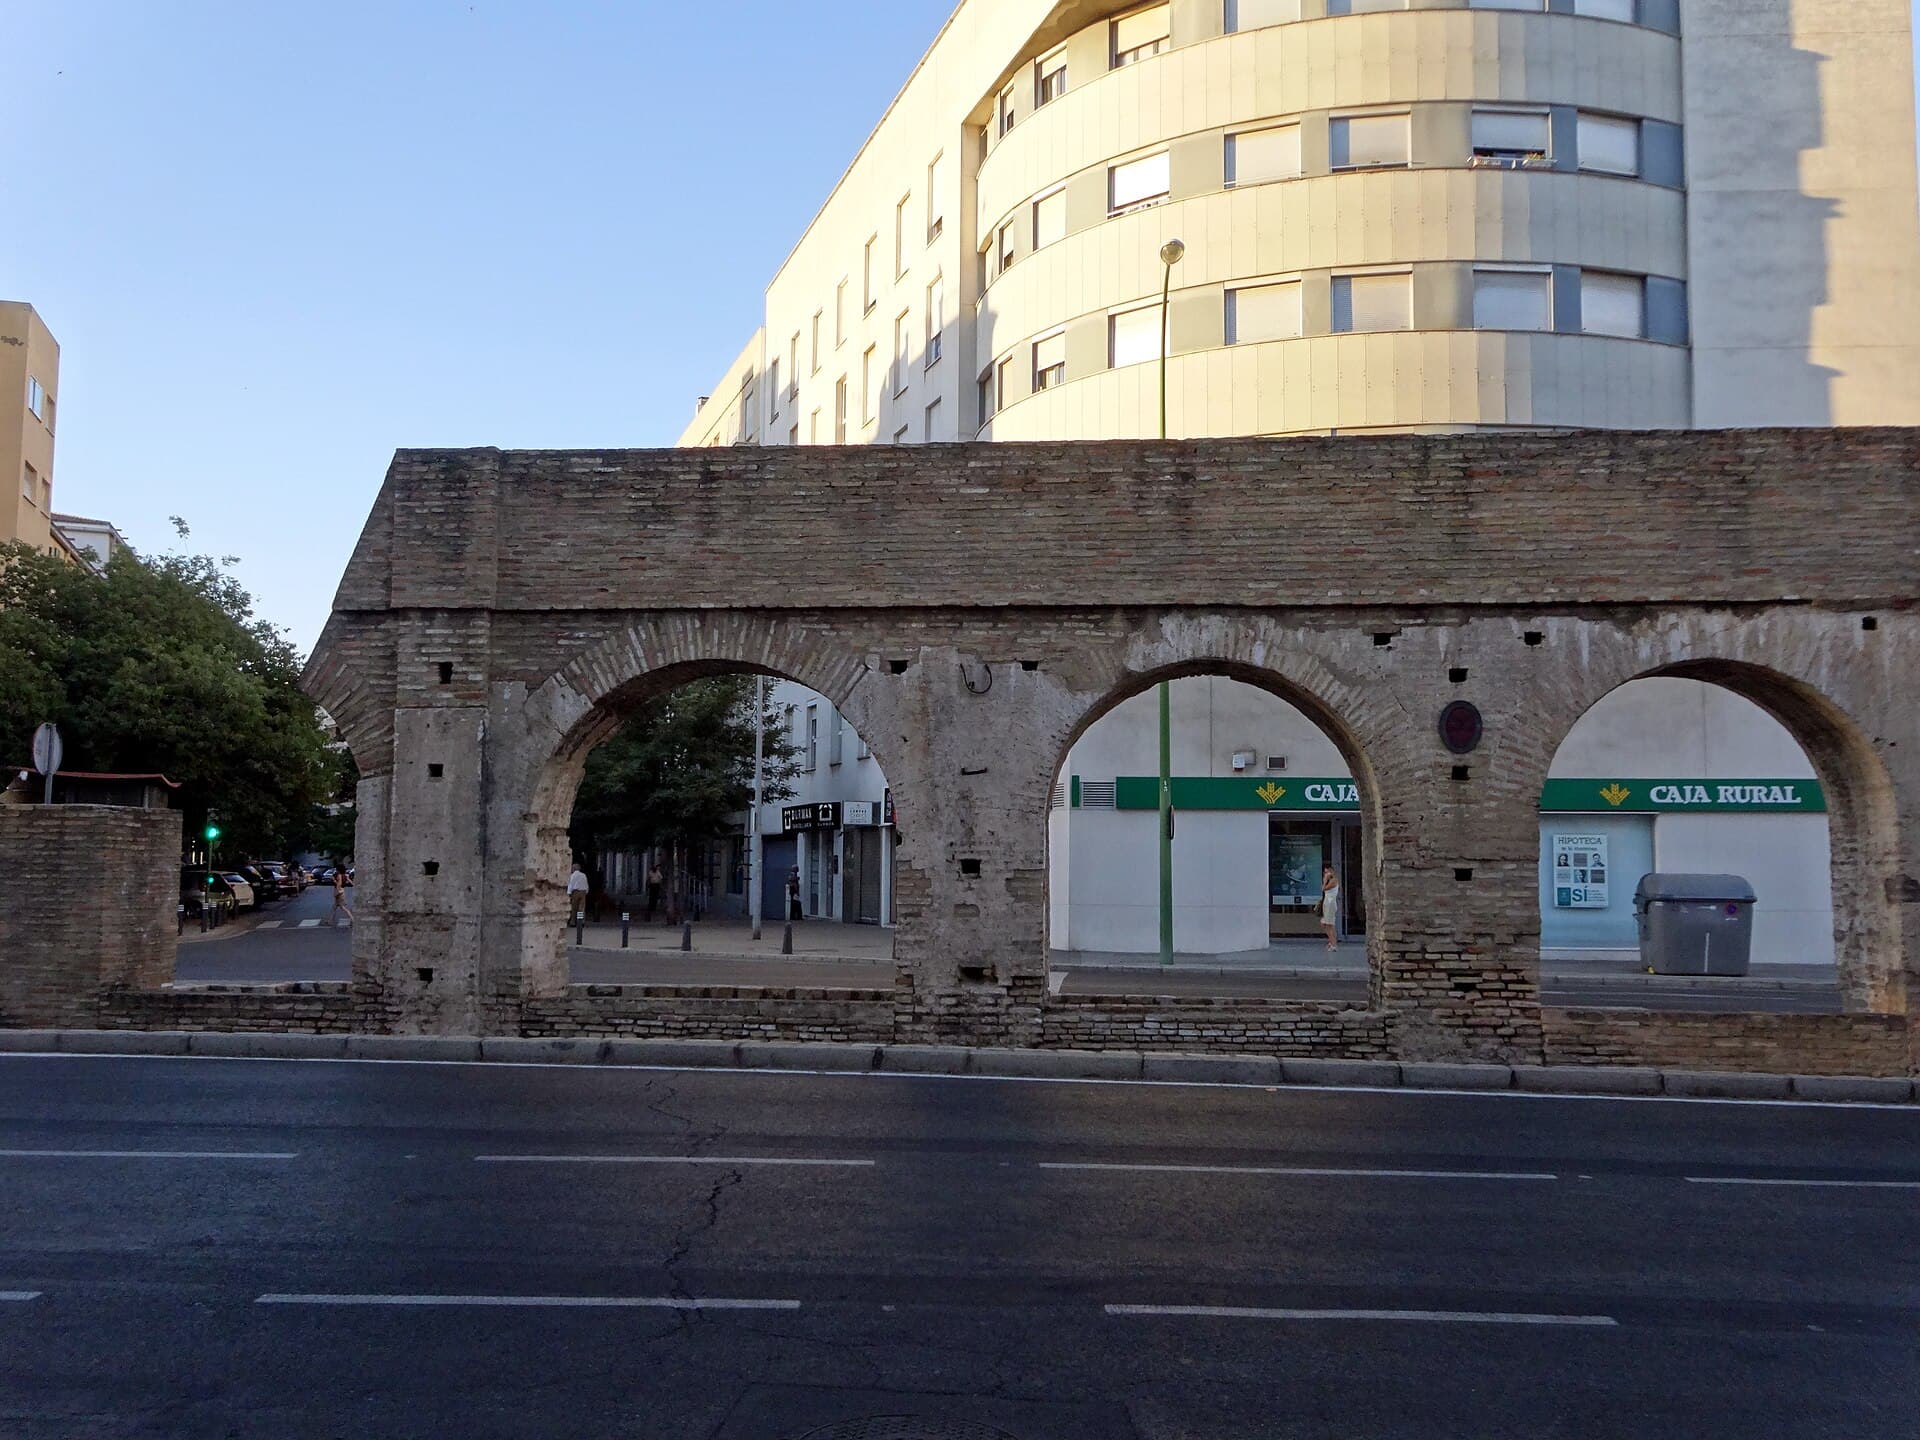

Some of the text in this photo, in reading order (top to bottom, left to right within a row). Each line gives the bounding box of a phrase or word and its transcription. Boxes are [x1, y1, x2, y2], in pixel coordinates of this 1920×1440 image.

[1305, 784, 1360, 803] CAJA
[1649, 785, 1802, 804] CAJA RURAL
[1558, 836, 1602, 845] HIPOTECA
[1571, 885, 1588, 902] SÍ
